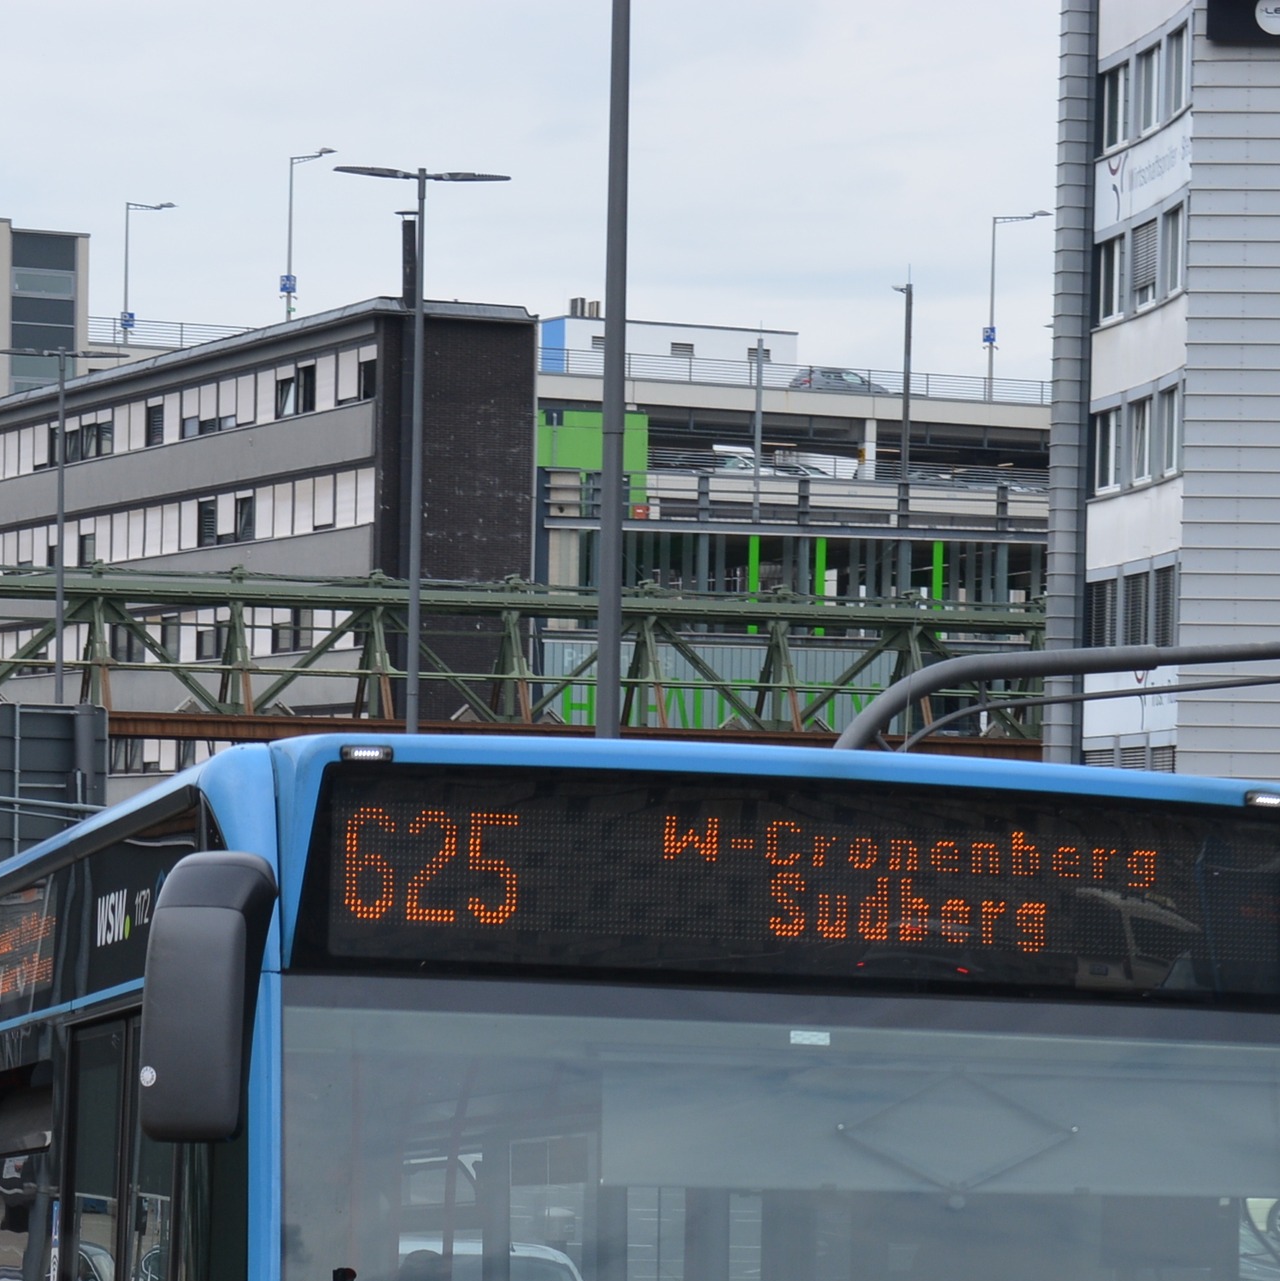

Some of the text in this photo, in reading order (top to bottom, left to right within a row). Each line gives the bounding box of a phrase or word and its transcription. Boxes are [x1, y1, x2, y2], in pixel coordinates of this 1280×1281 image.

[344, 806, 1158, 924] 625 W-Cronenberg
[769, 871, 1047, 953] Sudberg
